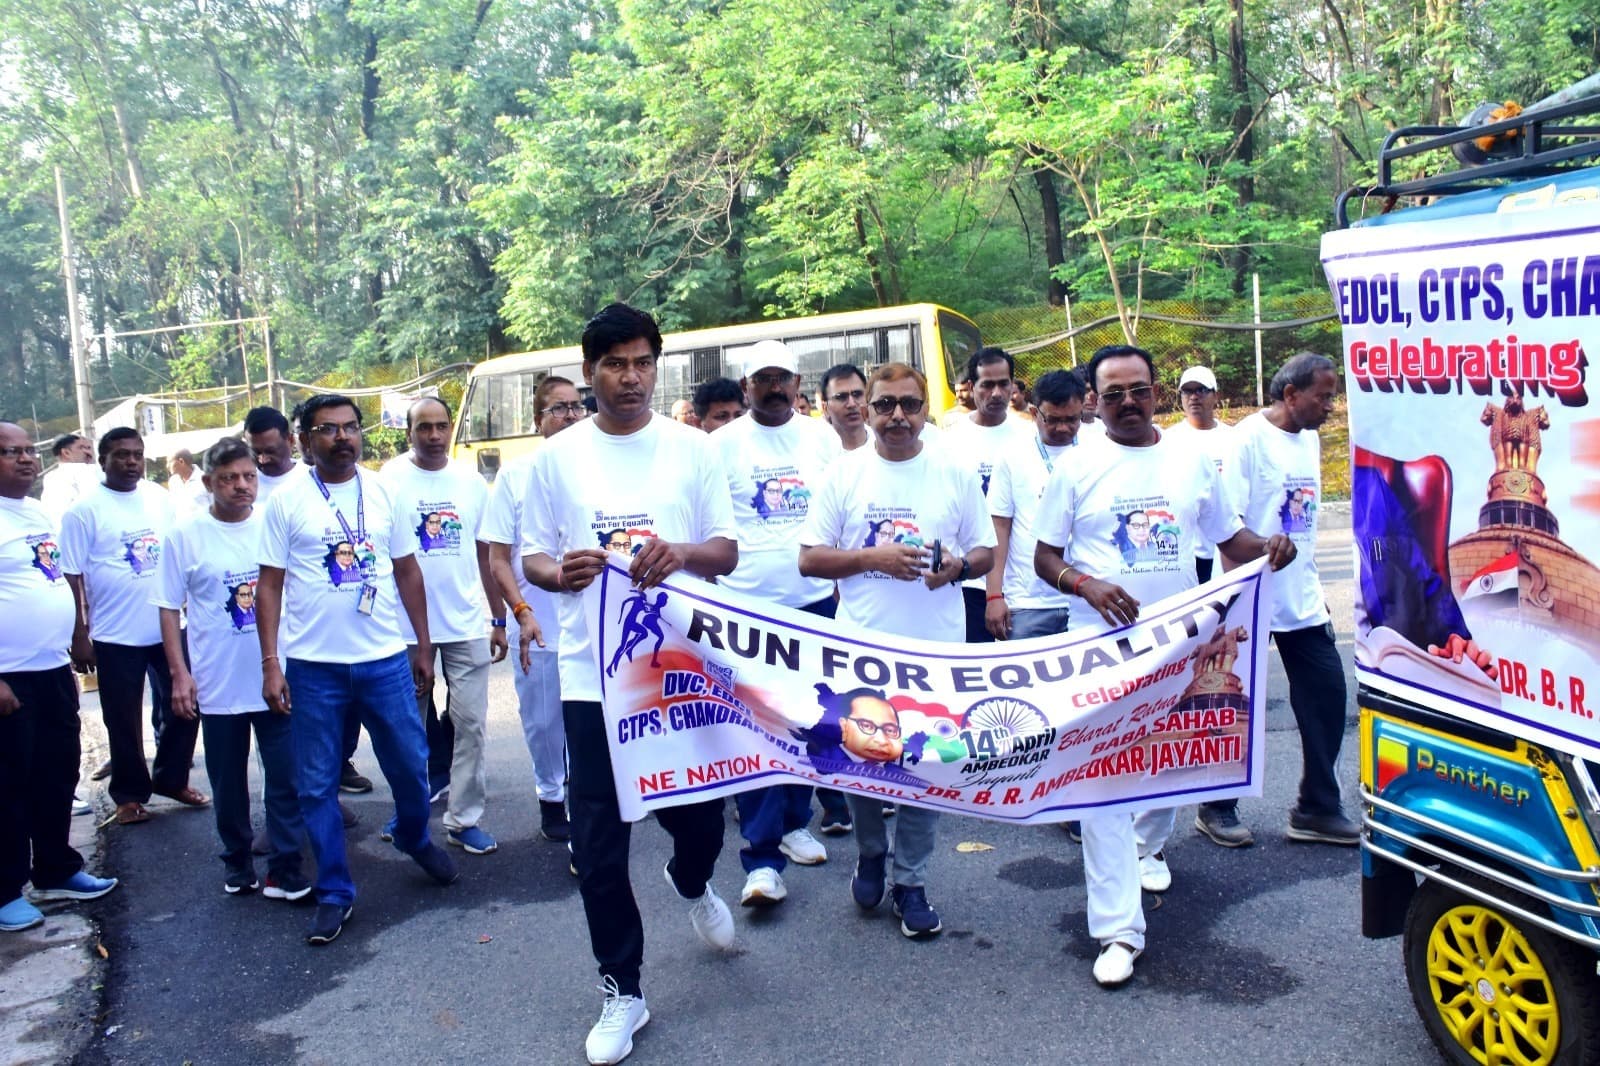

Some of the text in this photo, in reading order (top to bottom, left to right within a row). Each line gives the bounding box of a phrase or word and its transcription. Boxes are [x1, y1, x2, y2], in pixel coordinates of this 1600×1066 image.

[1337, 254, 1600, 328] EDCL, CTPS, CHA
[1350, 335, 1582, 391] Celebrating
[591, 518, 654, 530] Run For Equality
[686, 592, 1242, 693] RUN FOR EQUALITY
[664, 672, 707, 697] DVC,
[1071, 656, 1189, 708] Celebrating
[1498, 658, 1594, 720] DR. B. R.
[618, 701, 800, 756] CTPS, CHANDRAPURA
[960, 727, 1056, 760] 14th April
[1057, 694, 1178, 751] Bharat Ratna
[1091, 708, 1235, 756] BABA SAHAB
[634, 770, 677, 794] NE
[687, 754, 761, 785] NATION
[926, 736, 1241, 805] DR. B. R. AMBEDKAR JAYANTI
[950, 763, 1043, 791] Jayanti
[960, 749, 1051, 774] AMBEDKAR
[1416, 747, 1531, 807] Panther
